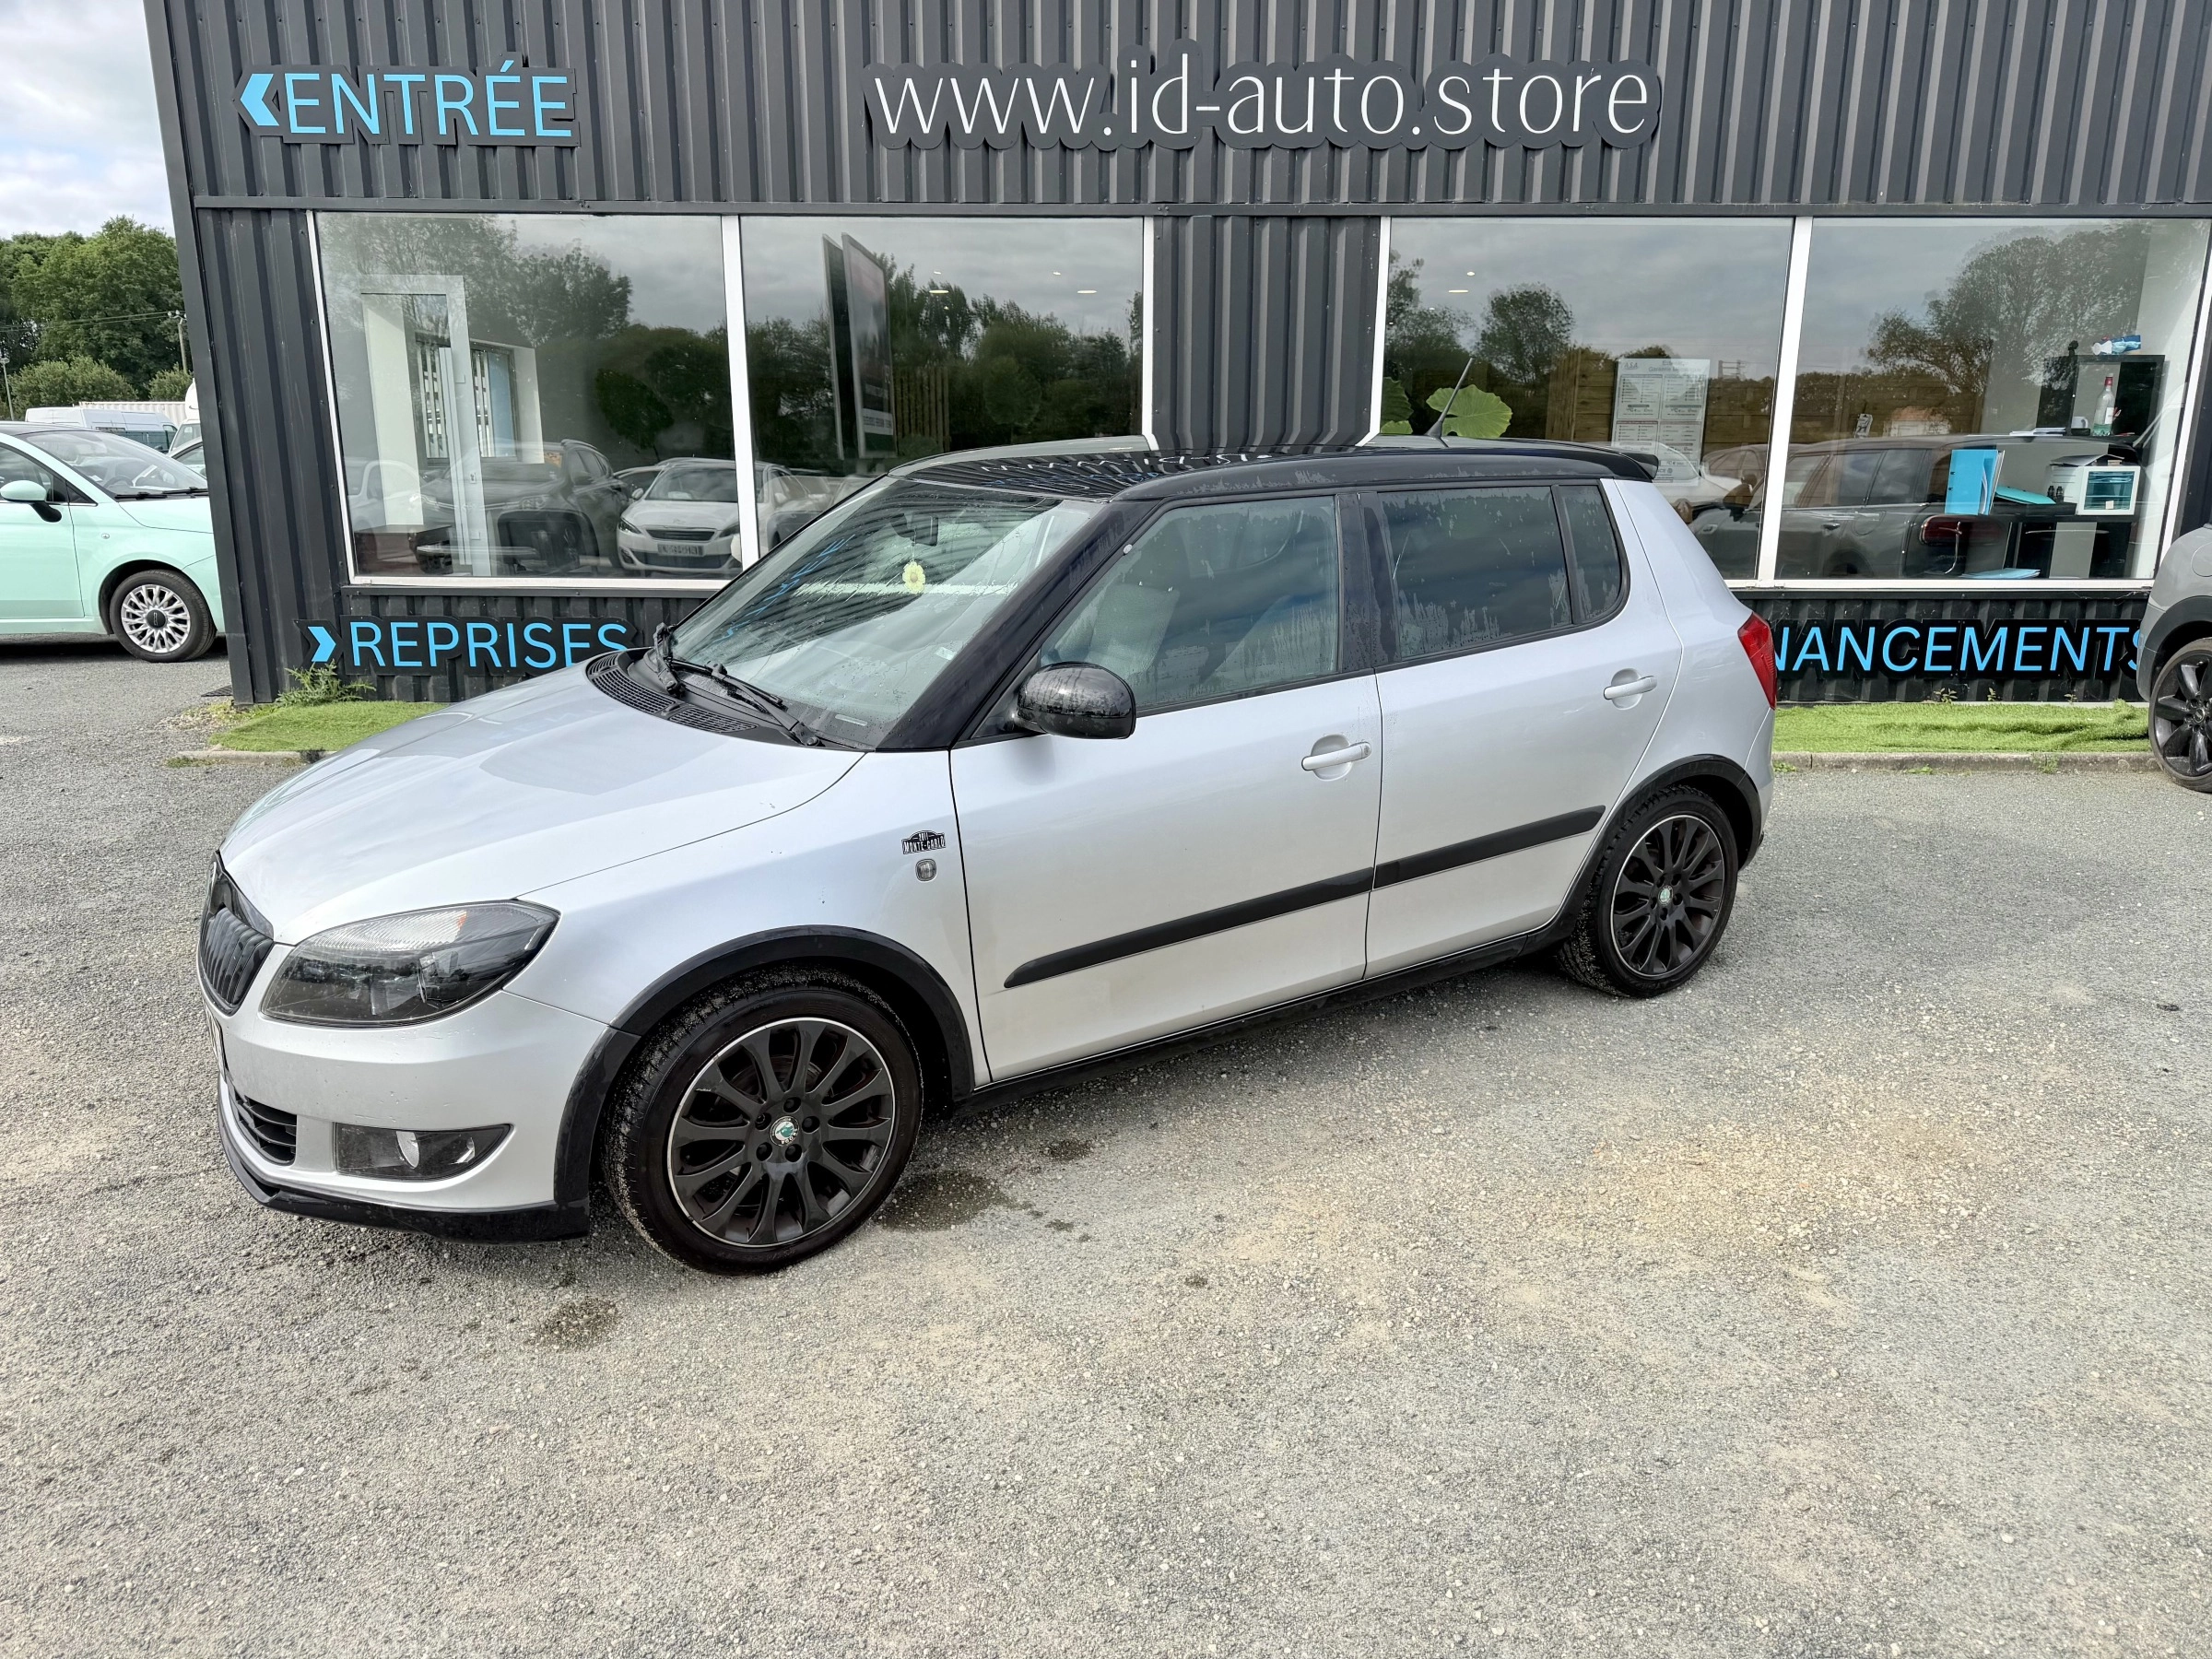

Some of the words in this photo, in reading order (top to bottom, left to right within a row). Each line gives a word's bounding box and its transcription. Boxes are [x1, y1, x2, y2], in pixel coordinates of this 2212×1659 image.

[285, 60, 572, 137] ENTRÉE
[874, 53, 1648, 136] www.id-auto.store
[350, 621, 628, 670] REPRISES
